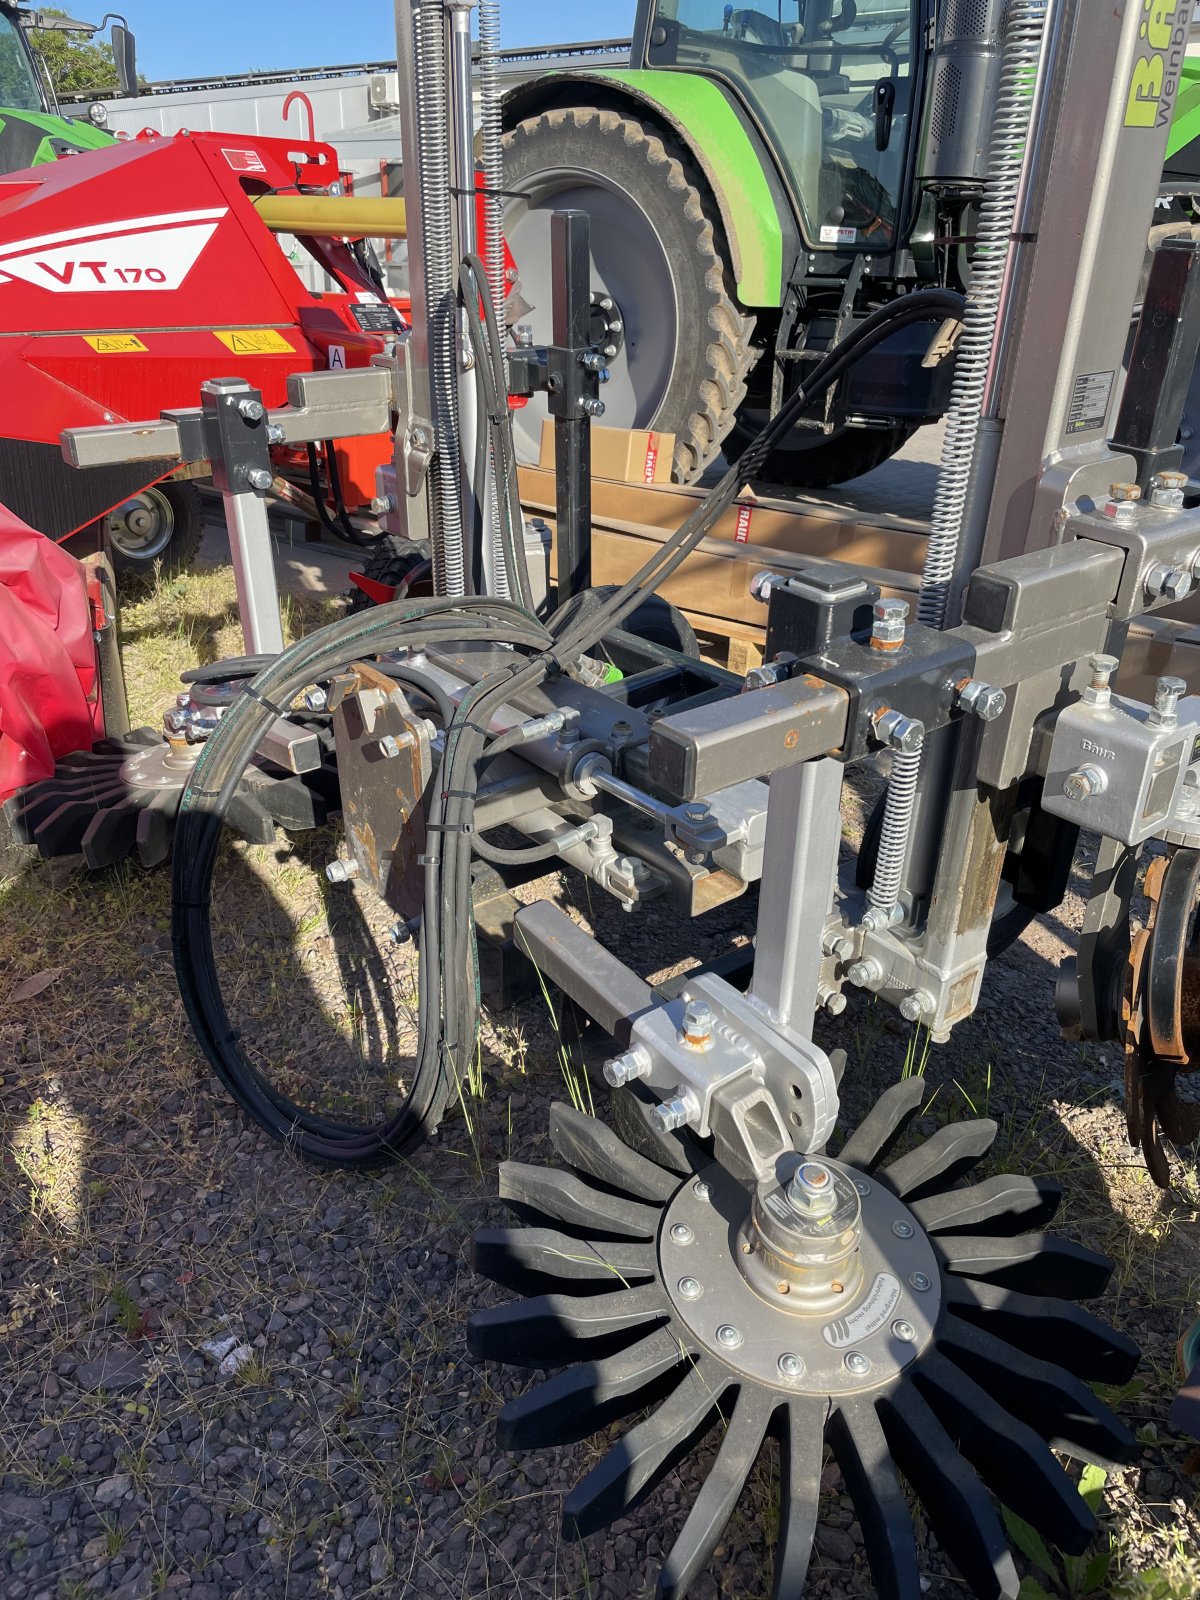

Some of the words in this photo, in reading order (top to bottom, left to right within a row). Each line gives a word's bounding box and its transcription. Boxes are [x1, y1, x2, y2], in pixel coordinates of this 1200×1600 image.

[1156, 0, 1190, 128] Weinba
[34, 261, 107, 285] VT
[113, 268, 167, 284] 170
[332, 348, 344, 368] A
[736, 510, 750, 543] RAUC
[848, 1312, 865, 1325] rechts
[865, 1317, 881, 1331] mittel
